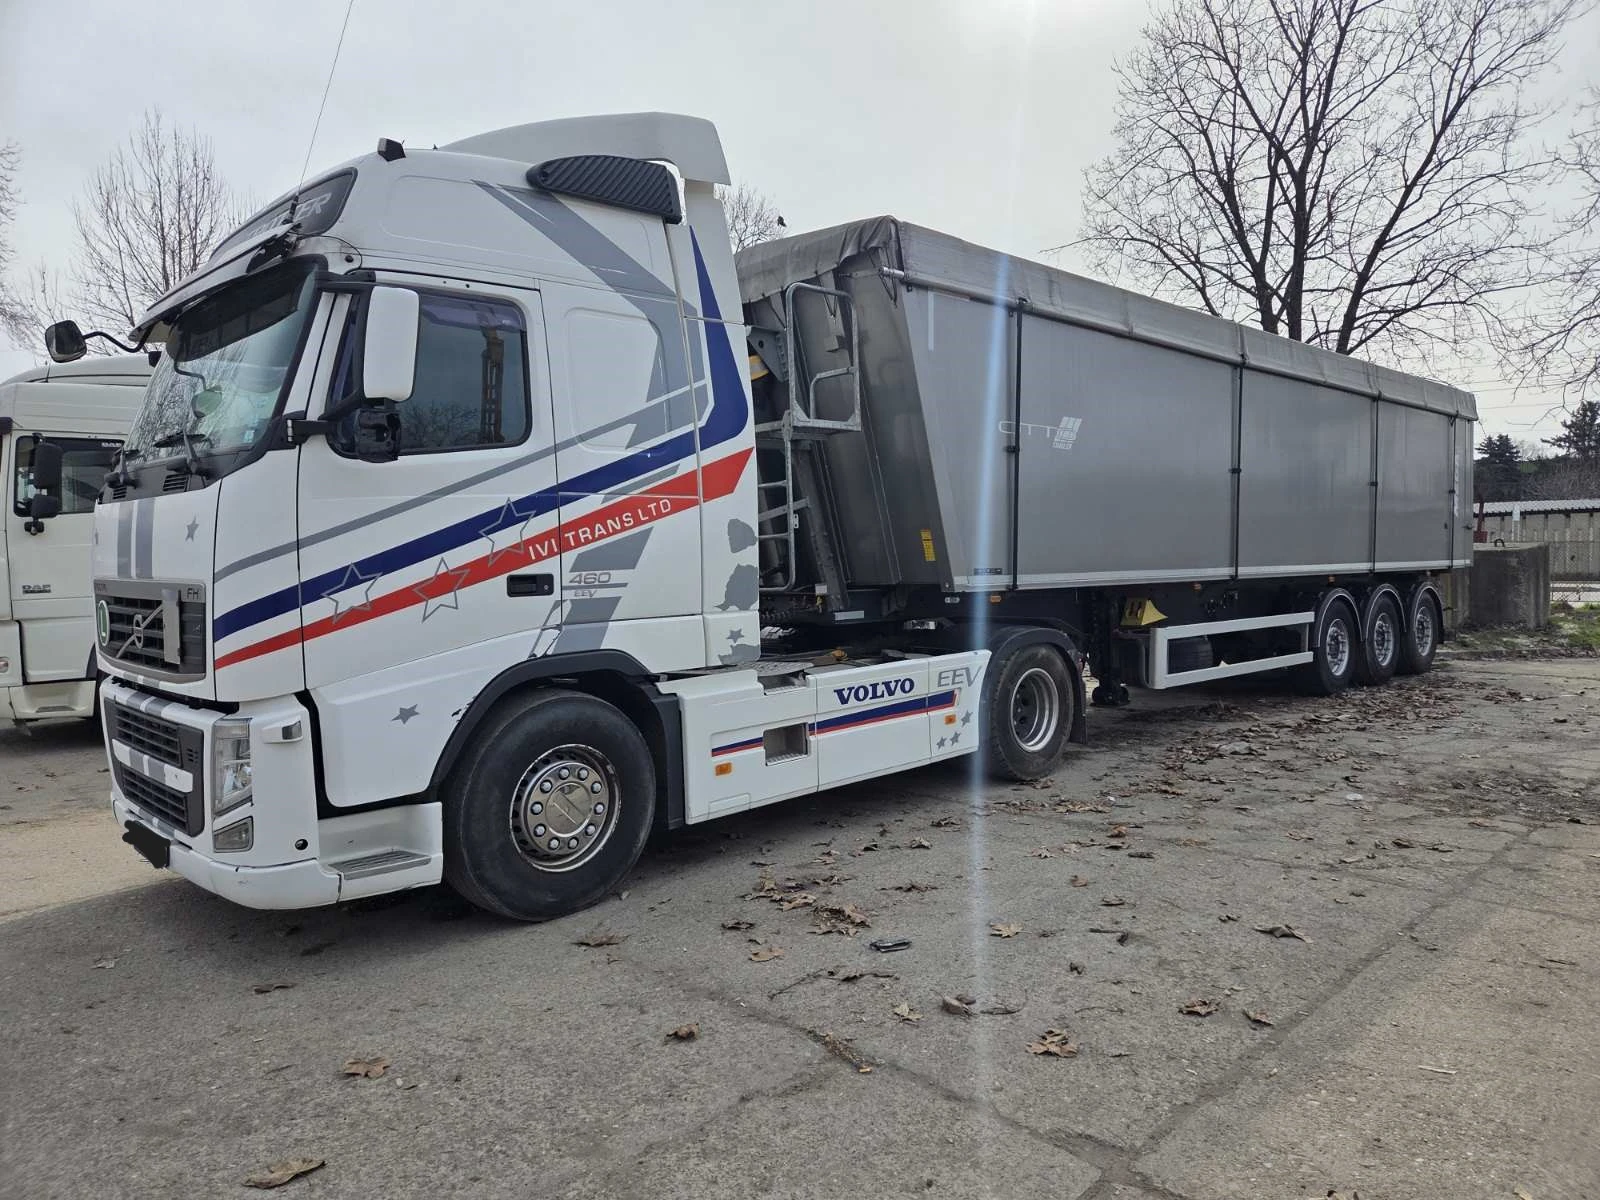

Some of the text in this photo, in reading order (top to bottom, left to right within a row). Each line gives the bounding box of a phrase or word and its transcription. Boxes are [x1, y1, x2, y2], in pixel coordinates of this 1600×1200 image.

[528, 498, 671, 560] IVI TRANS LTD
[569, 572, 612, 585] 460
[186, 587, 200, 600] FH
[574, 589, 597, 598] EEV
[833, 666, 982, 705] VOLVO EEV
